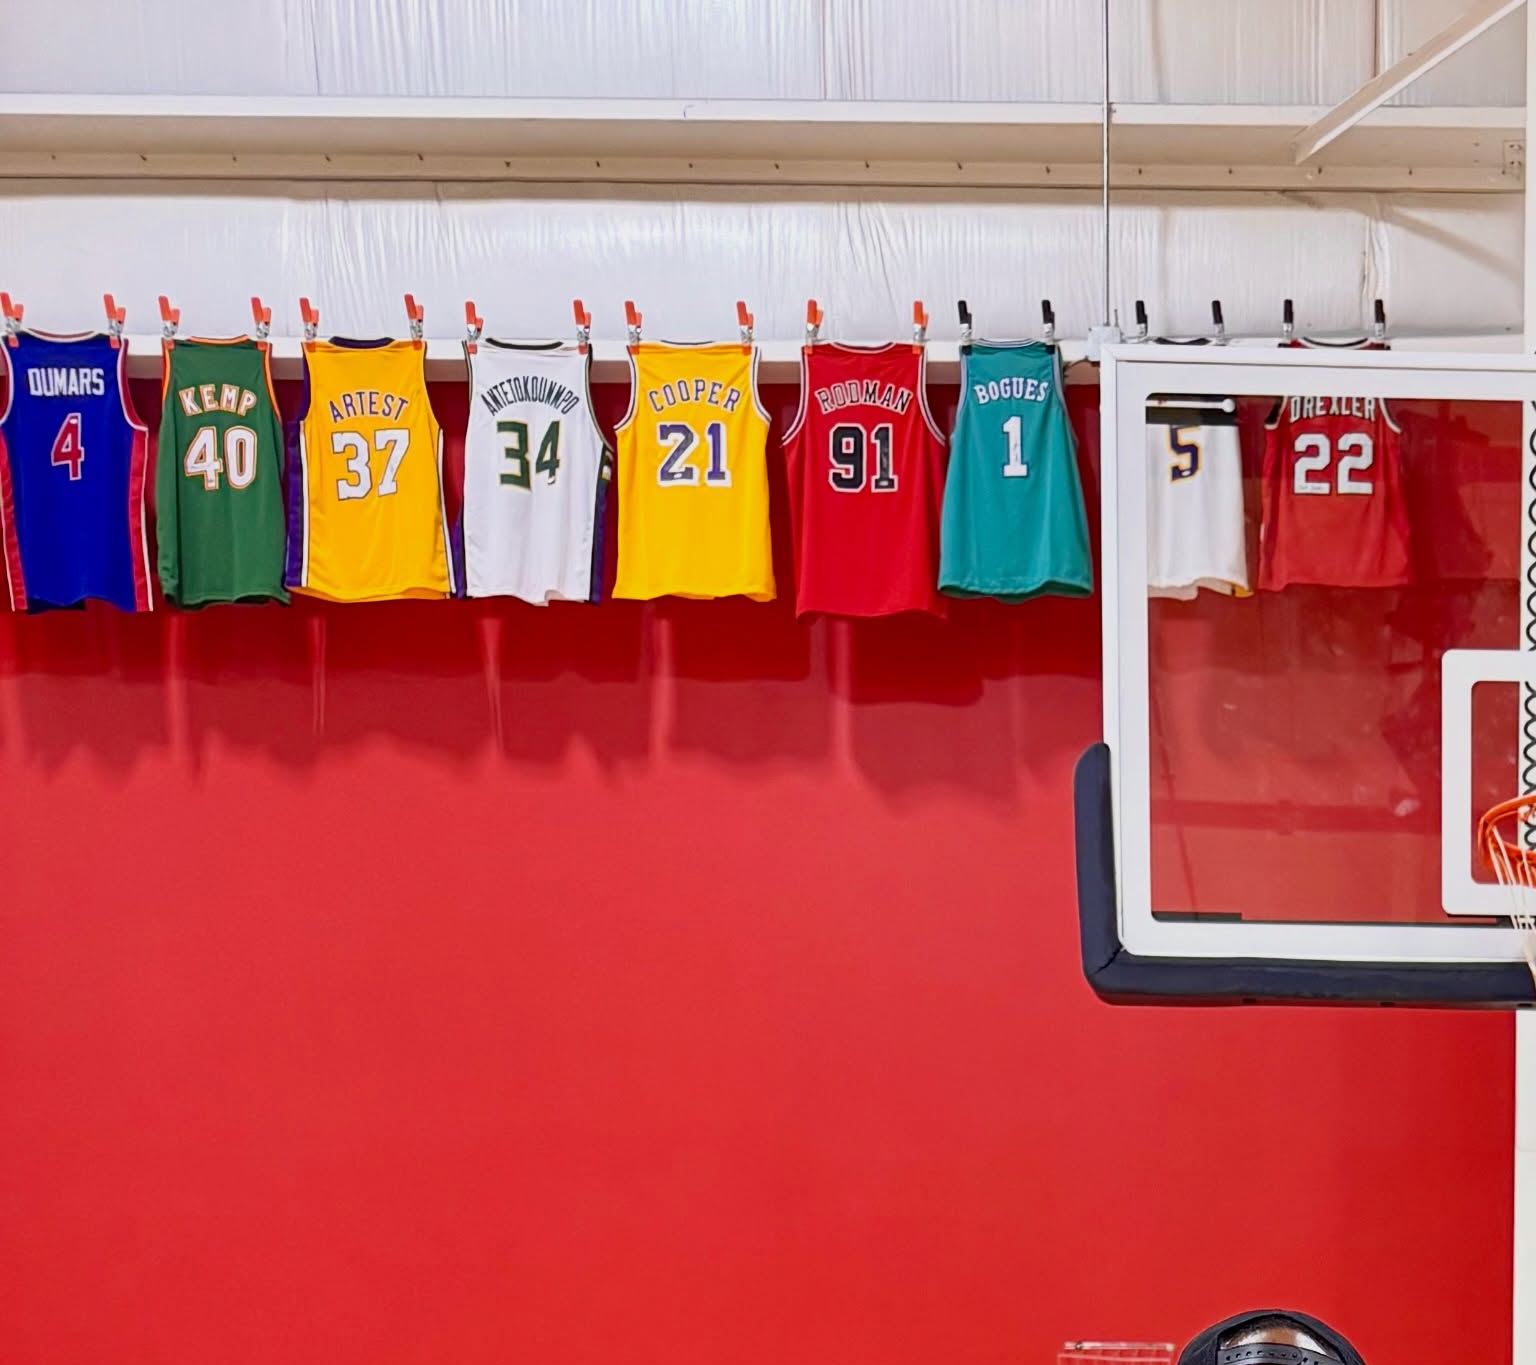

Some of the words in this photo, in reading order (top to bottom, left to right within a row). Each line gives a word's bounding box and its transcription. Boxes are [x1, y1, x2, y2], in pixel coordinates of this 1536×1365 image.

[27, 366, 105, 398] DUMARS
[178, 382, 259, 418] KEMP
[328, 391, 410, 424] ARTEST
[648, 378, 742, 414] COOPER
[815, 379, 912, 415] RODMAN
[973, 377, 1048, 406] BOGUES
[1289, 395, 1377, 423] DREXLER
[51, 413, 85, 480] 4
[183, 425, 259, 491] 40
[331, 427, 411, 501] 37
[497, 419, 562, 494] 34
[657, 422, 732, 489] 21
[828, 423, 899, 493] 91
[1002, 415, 1029, 478] 1
[1166, 424, 1202, 484] 5
[1294, 432, 1374, 495] 22
